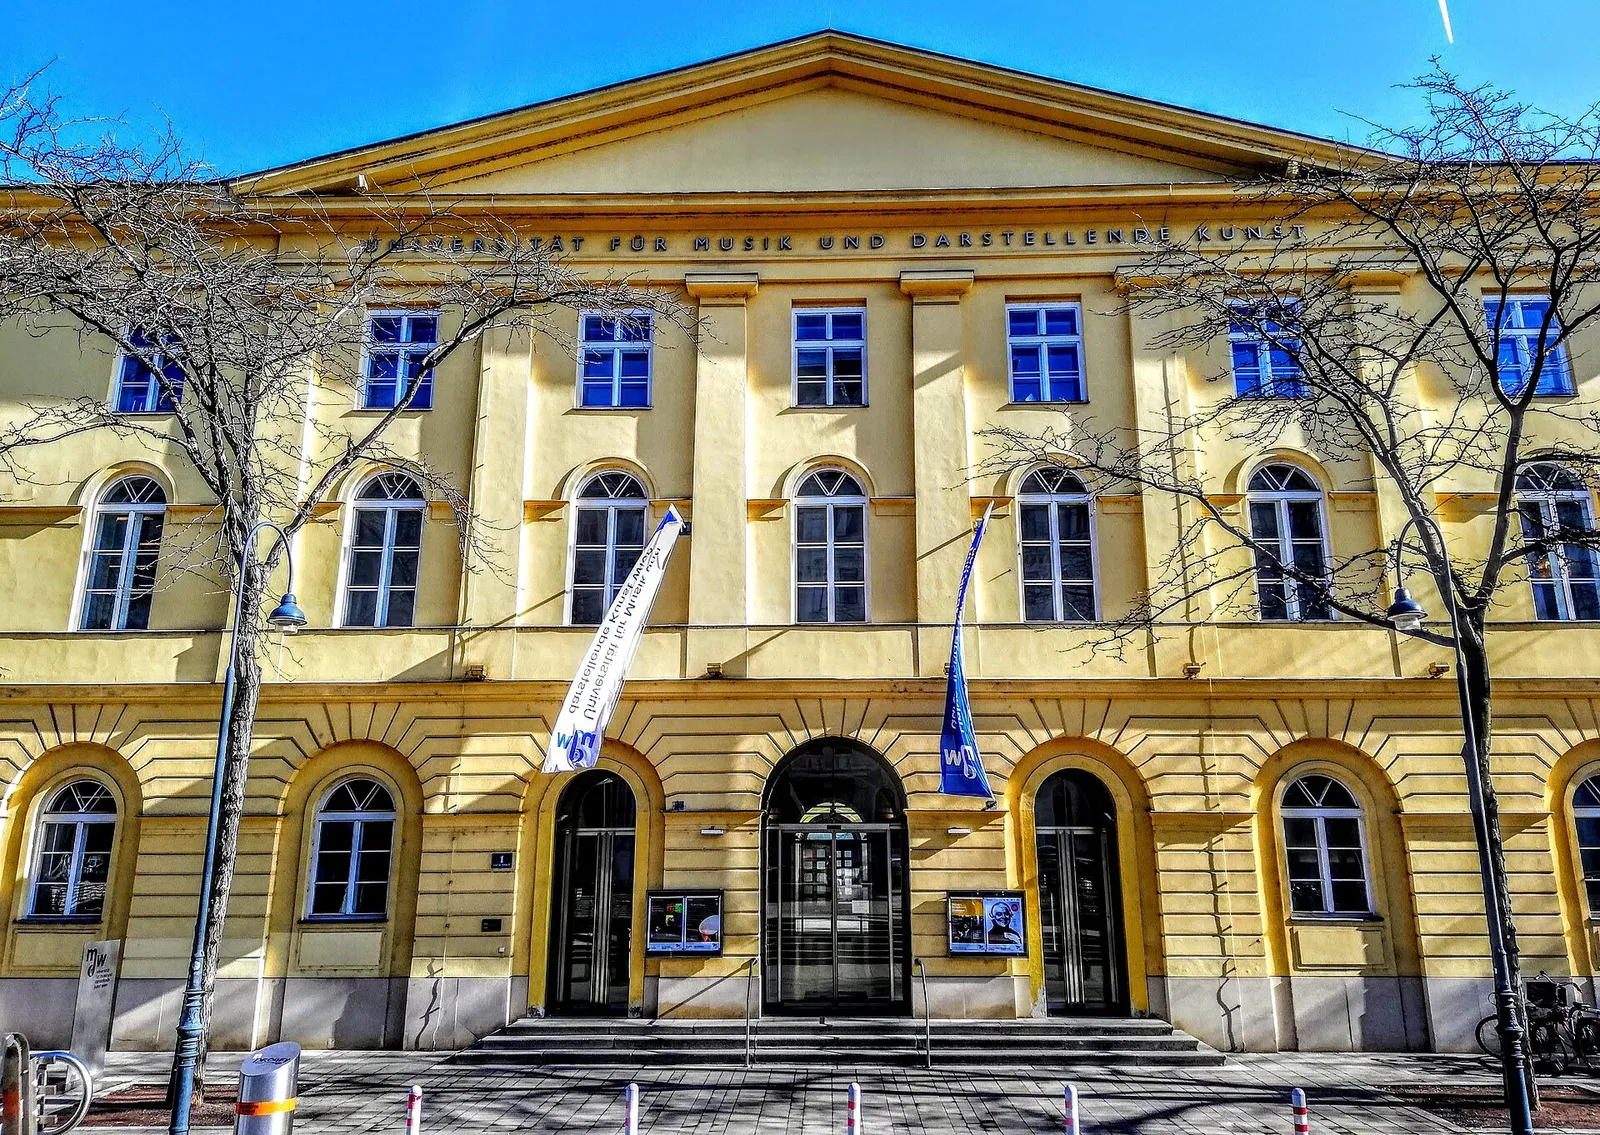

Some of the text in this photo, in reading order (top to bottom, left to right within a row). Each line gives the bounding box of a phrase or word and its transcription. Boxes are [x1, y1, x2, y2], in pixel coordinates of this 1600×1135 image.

[365, 223, 1306, 253] UNVERSTÄT FÜR MUSIK UND DARSTELLENDE KUNST
[499, 855, 504, 864] 1
